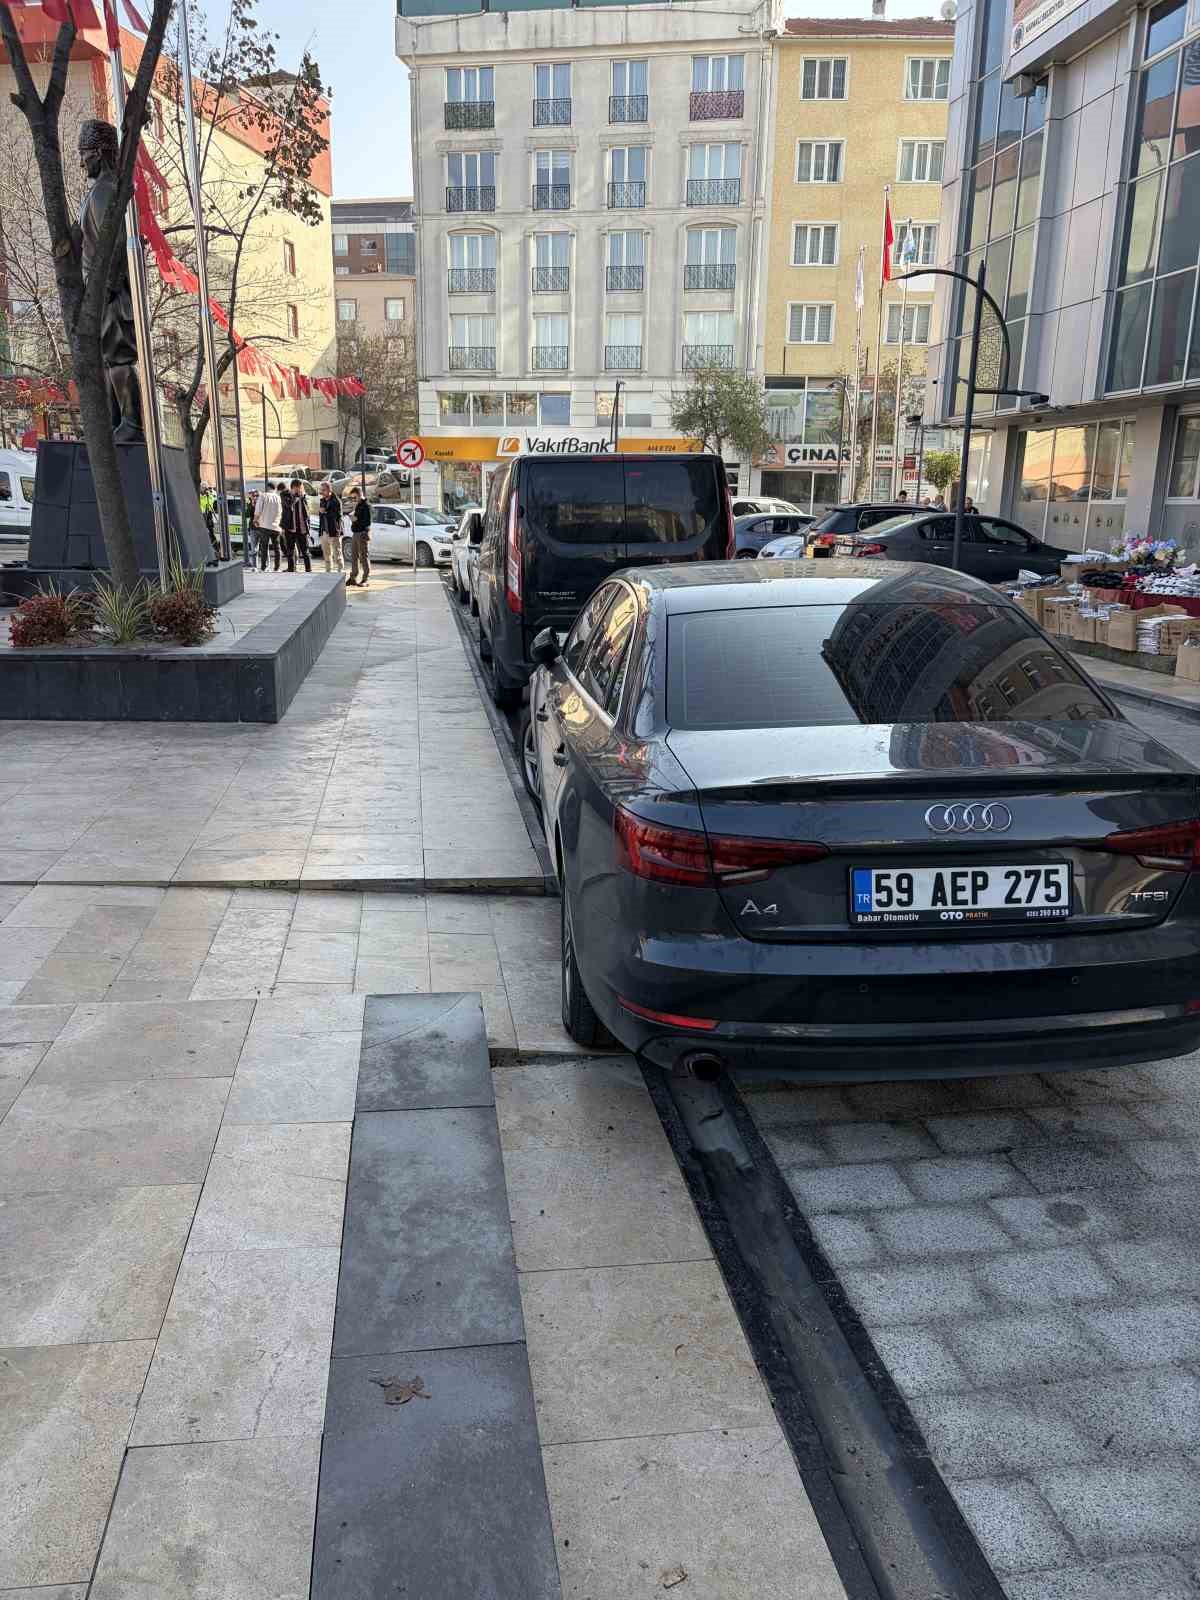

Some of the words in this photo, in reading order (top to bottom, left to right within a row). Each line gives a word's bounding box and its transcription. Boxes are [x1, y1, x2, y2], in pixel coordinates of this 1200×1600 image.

[527, 437, 609, 453] VakıfBank
[787, 448, 851, 463] ÇINAR
[875, 873, 913, 907] 59
[931, 871, 989, 906] AEP
[1004, 869, 1062, 904] 275
[857, 893, 871, 904] TR
[1130, 891, 1169, 901] TFSI
[740, 899, 778, 915] A4
[857, 914, 881, 922] Bahar
[883, 913, 919, 921] Otomotiv
[940, 911, 963, 920] OTO
